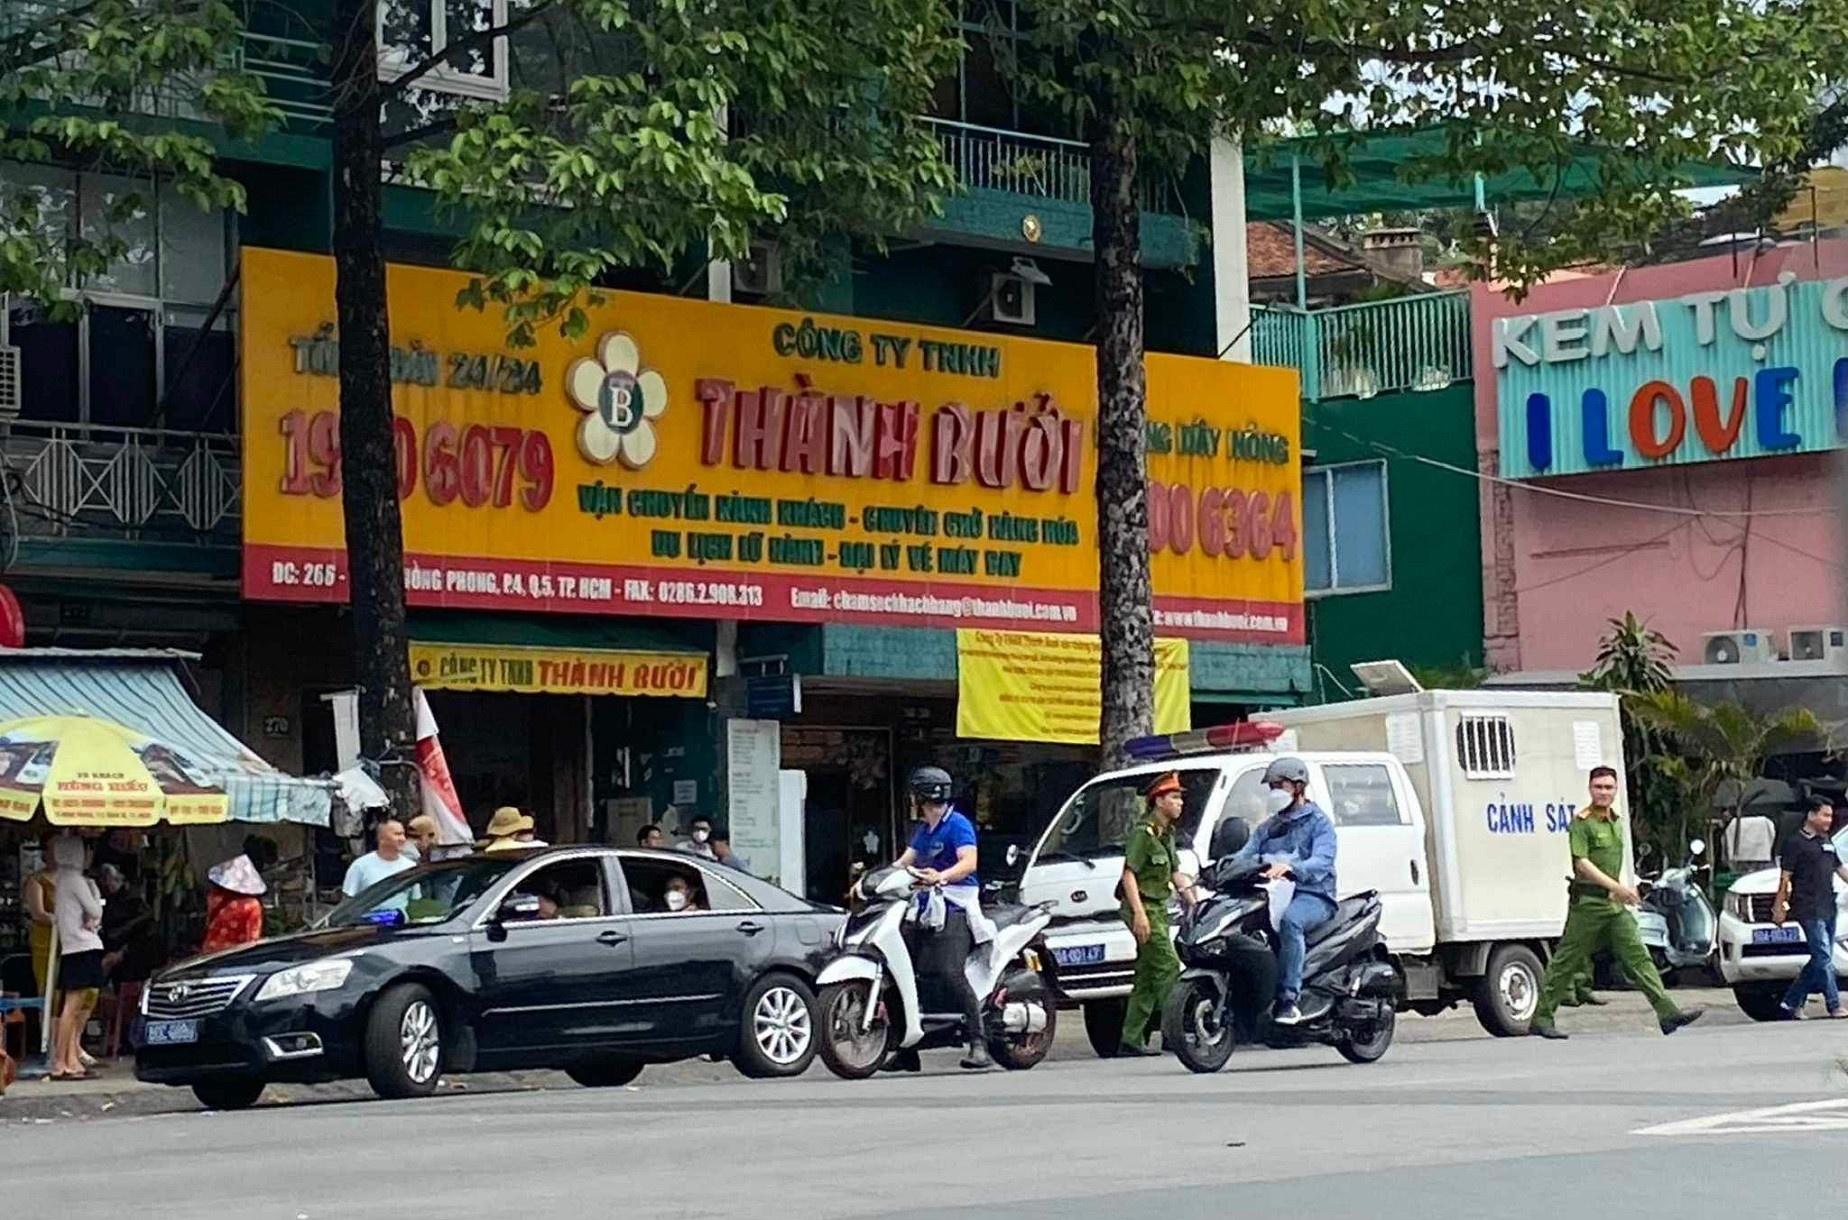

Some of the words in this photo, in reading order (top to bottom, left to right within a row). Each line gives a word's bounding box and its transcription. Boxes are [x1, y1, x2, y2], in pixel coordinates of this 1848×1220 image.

[1491, 301, 1664, 368] KEM
[1684, 271, 1797, 362] TỰ
[774, 317, 862, 364] CÔNG
[870, 333, 912, 369] TY
[918, 340, 1001, 378] TNHH
[447, 352, 542, 395] 24/24
[609, 386, 633, 427] B
[1582, 366, 1802, 467] LOVE
[695, 373, 919, 480] THÀNH
[931, 392, 1084, 494] BƯỞI
[579, 577, 612, 600] HCM
[538, 657, 625, 688] THÀNH
[1487, 791, 1534, 833] CẢNH
[1546, 797, 1576, 833] SÁT
